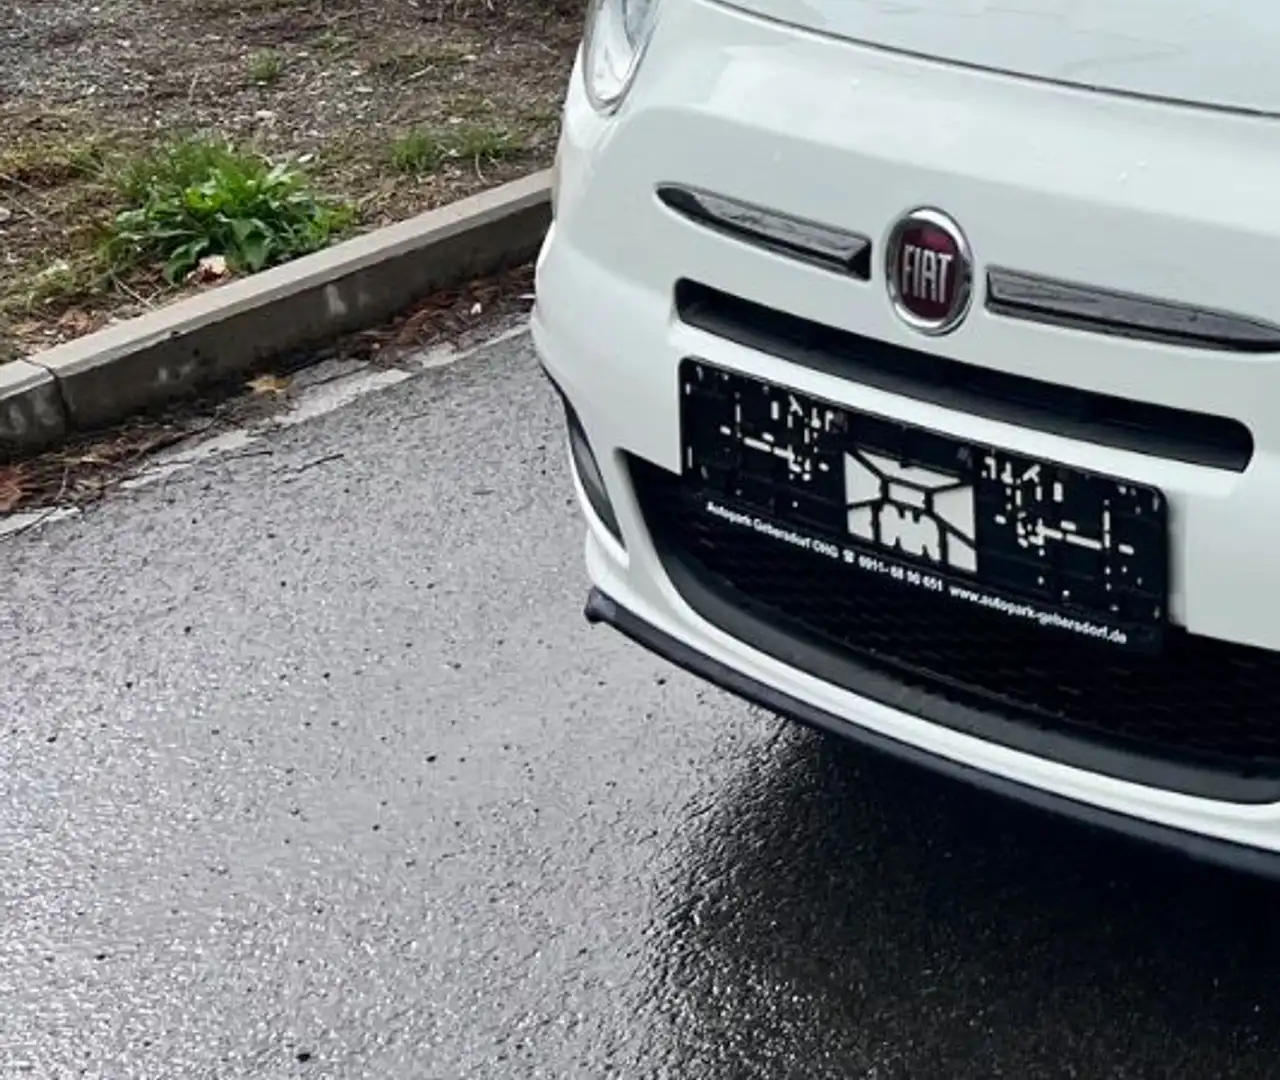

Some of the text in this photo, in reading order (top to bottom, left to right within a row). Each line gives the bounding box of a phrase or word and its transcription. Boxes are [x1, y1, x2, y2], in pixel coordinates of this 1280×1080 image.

[902, 243, 953, 304] FIAT
[706, 501, 752, 527] Autopark
[753, 518, 811, 549] Gebersdorf
[811, 539, 839, 558] OHG
[948, 584, 1127, 645] www.autopark-gebersdorf.de
